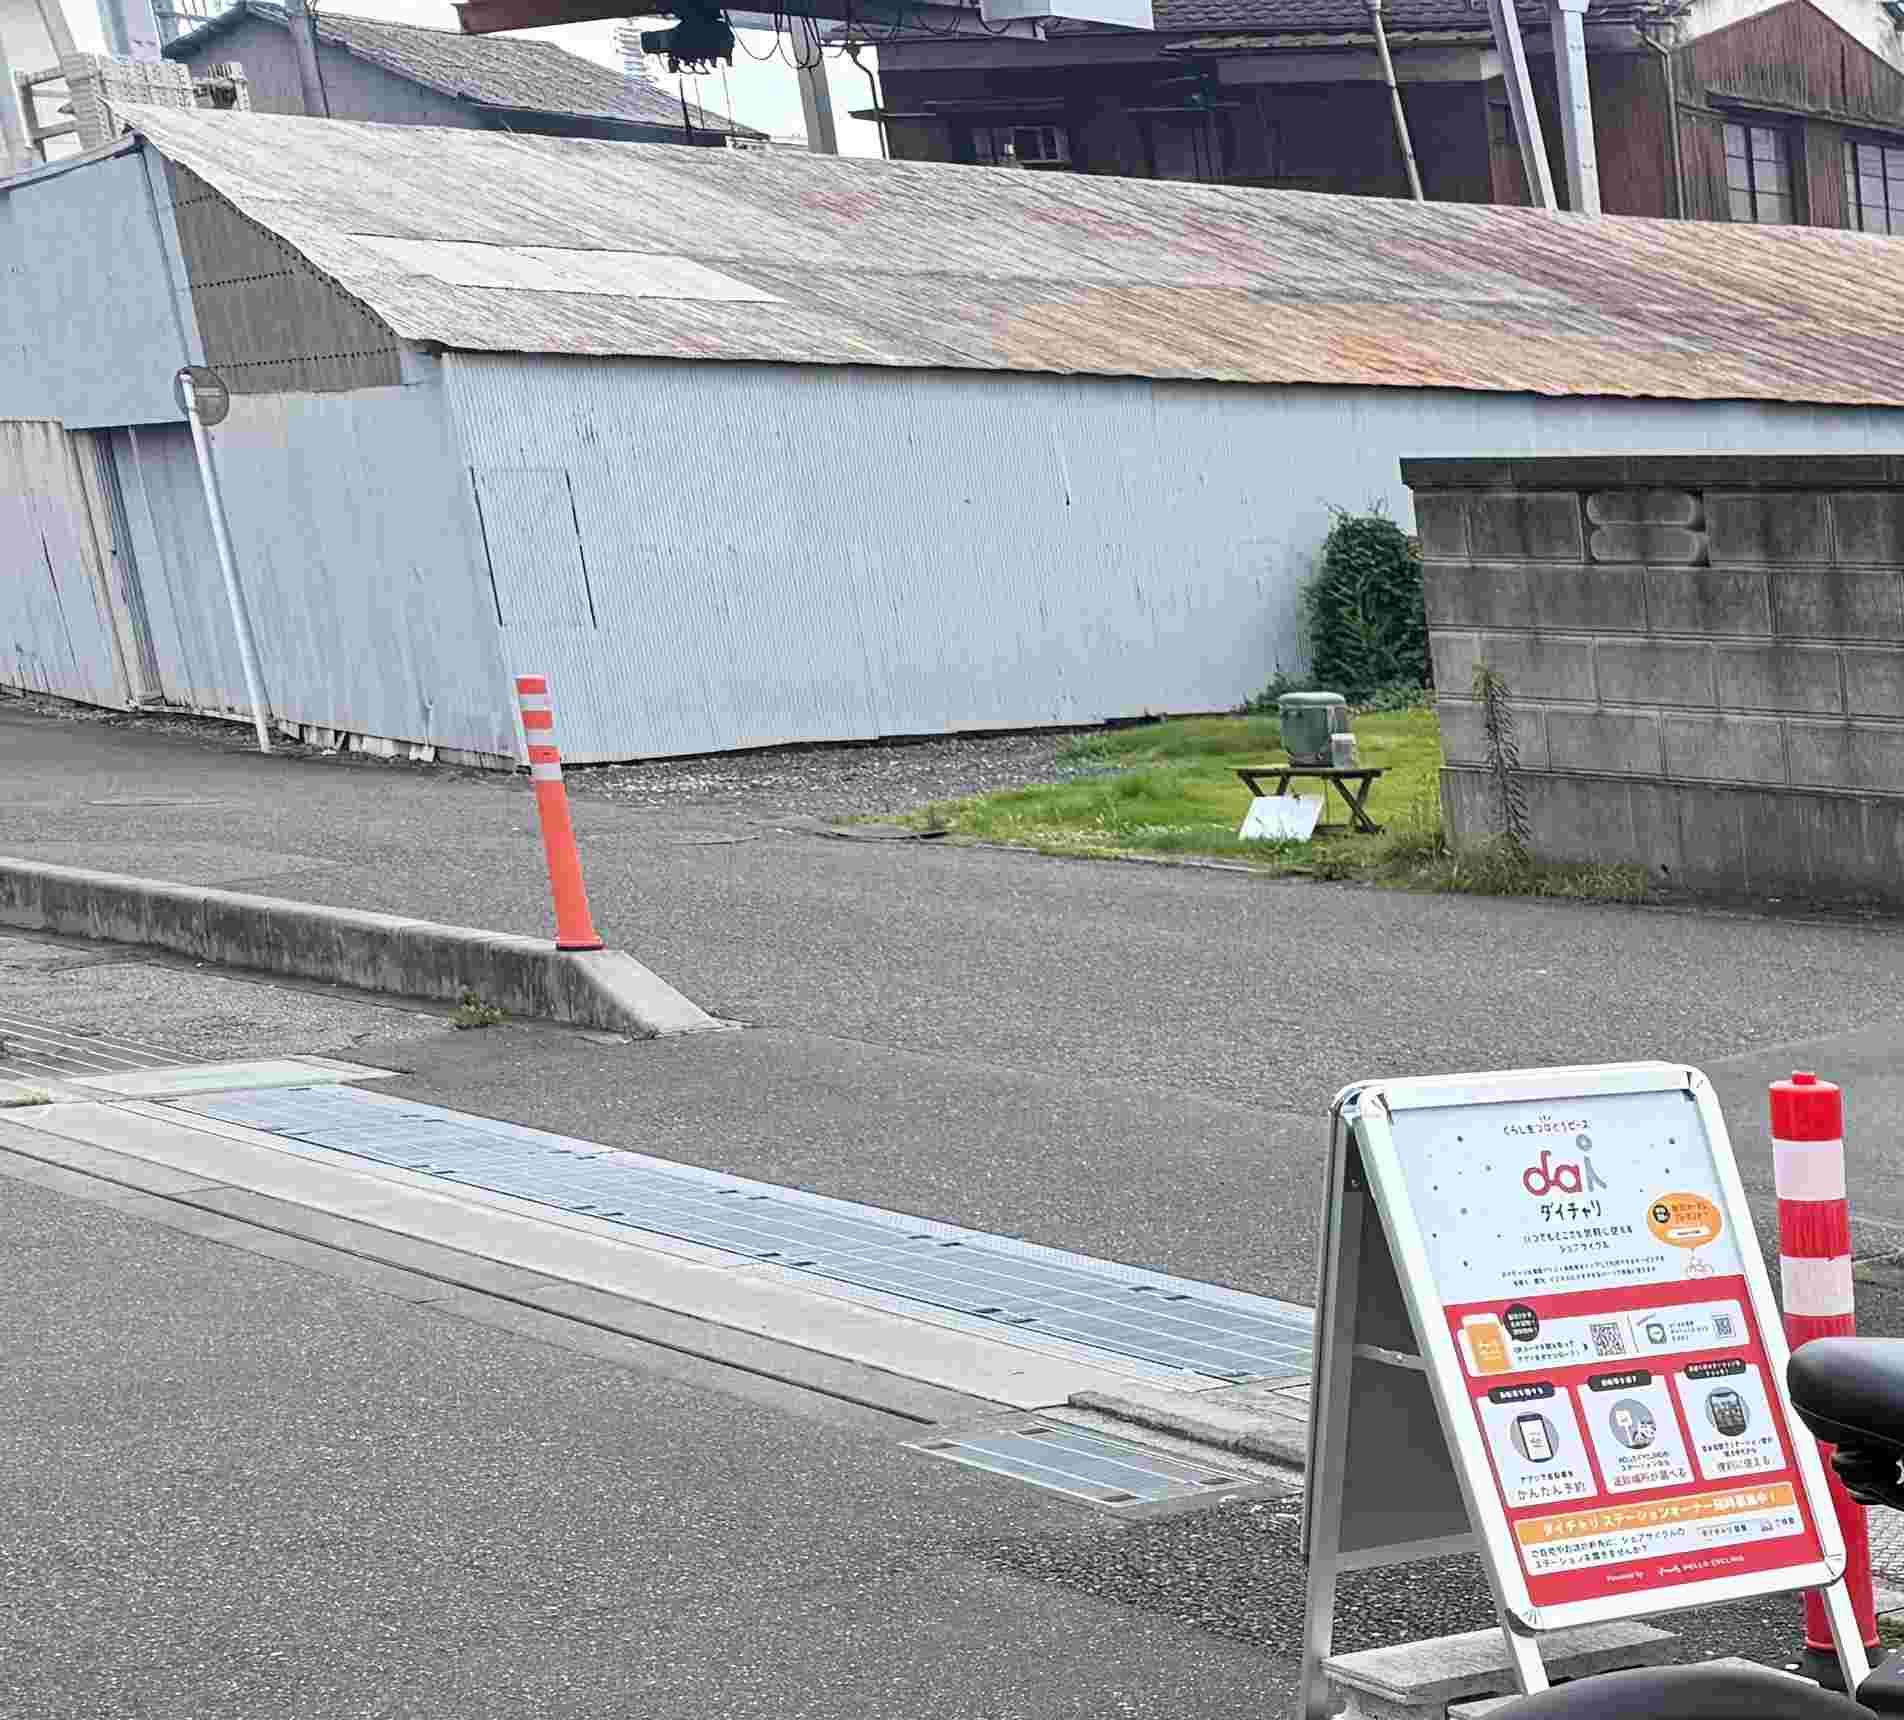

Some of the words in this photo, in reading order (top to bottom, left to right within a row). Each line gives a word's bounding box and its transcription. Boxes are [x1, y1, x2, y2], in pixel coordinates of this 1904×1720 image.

[1540, 1199, 1601, 1222] ダイチャリ
[1517, 1481, 1586, 1501] かんたん予約
